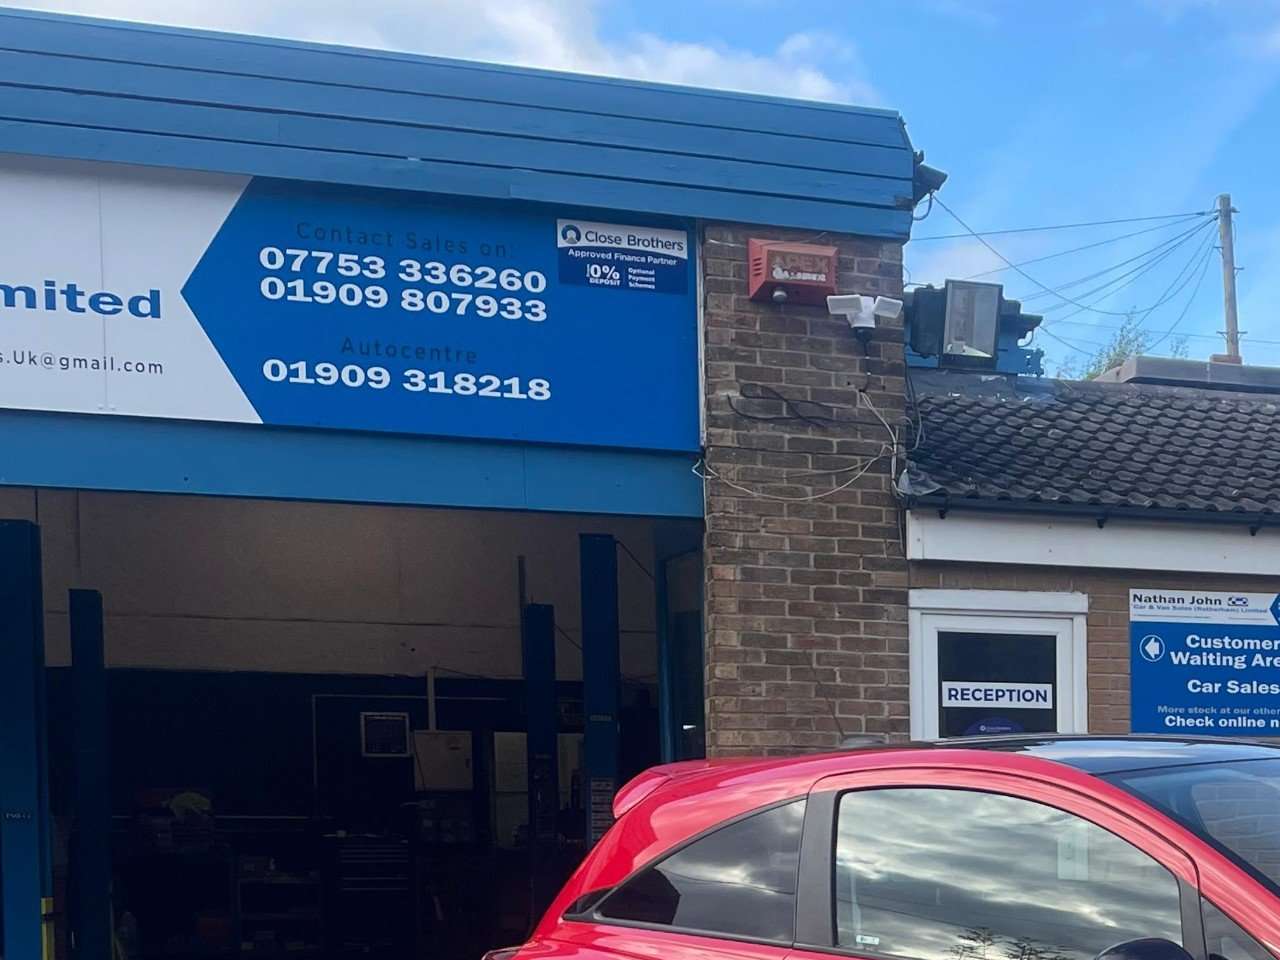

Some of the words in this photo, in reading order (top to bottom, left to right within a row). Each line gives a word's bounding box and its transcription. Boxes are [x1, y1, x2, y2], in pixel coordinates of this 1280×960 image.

[296, 221, 394, 247] Contact
[405, 231, 468, 254] Sales
[584, 230, 622, 246] Close
[627, 234, 684, 251] Brothers
[568, 248, 612, 260] Approved
[614, 252, 646, 263] Finance
[647, 255, 677, 266] Partner
[259, 246, 387, 279] 07753
[398, 259, 547, 293] 336260
[260, 276, 389, 309] 01909
[400, 288, 547, 322] 807933
[341, 337, 478, 365] Autocentre
[262, 359, 391, 389] 01909
[402, 369, 551, 401] 318218
[1132, 593, 1185, 605] Nathan
[1189, 595, 1222, 606] John
[1186, 634, 1280, 650] Customer
[1170, 651, 1247, 669] Waiting
[947, 687, 1048, 702] RECEPTION
[1187, 679, 1221, 694] Car
[1226, 680, 1280, 694] Sales
[1157, 705, 1185, 714] More
[1187, 705, 1217, 715] stock
[1220, 706, 1230, 715] at
[1233, 707, 1250, 715] our
[1253, 706, 1280, 716] other
[1164, 715, 1215, 727] Check
[1218, 716, 1266, 728] online
